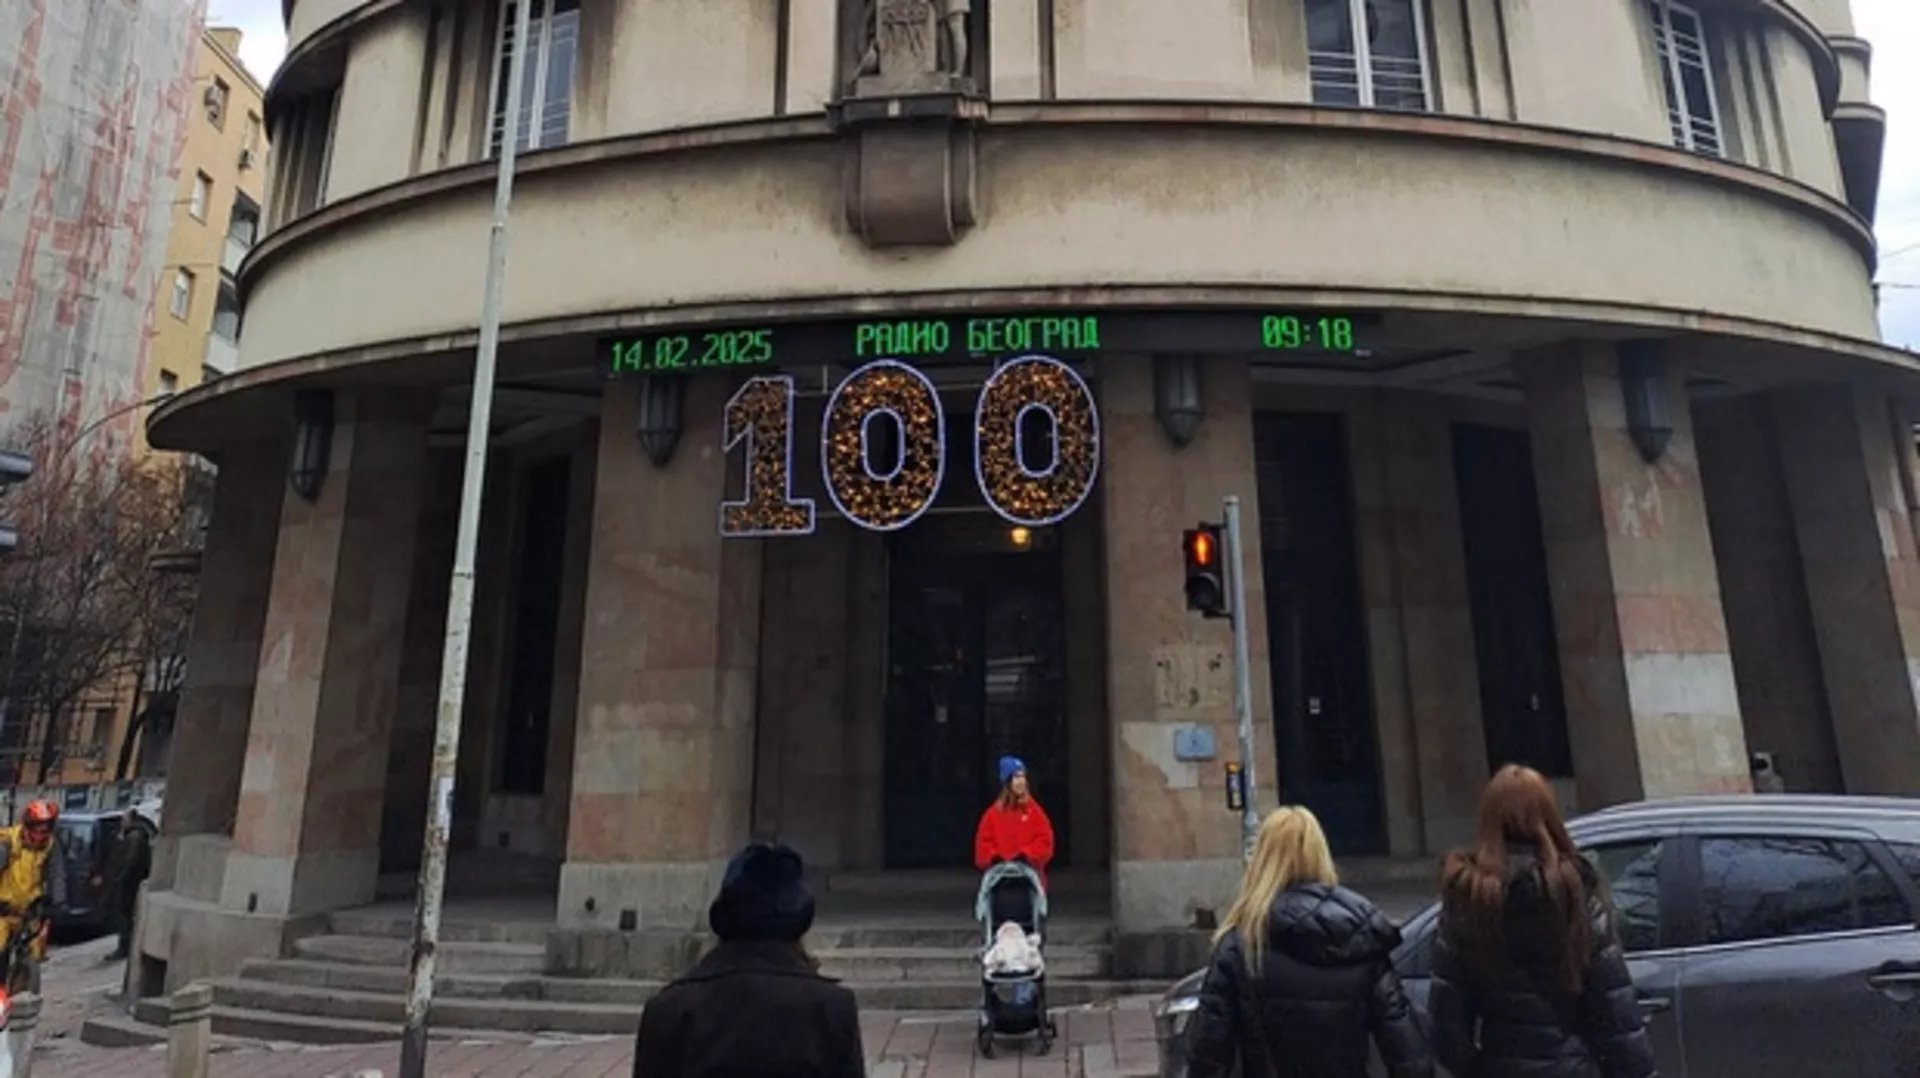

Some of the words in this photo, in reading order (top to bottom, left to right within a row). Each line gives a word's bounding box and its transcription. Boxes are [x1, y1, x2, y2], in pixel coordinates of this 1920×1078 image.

[611, 329, 773, 372] 14.02.2025
[856, 321, 949, 356] РАДИО
[967, 316, 1100, 351] БЕОГРАД
[1262, 315, 1352, 351] 09:18
[719, 355, 1100, 537] 100
